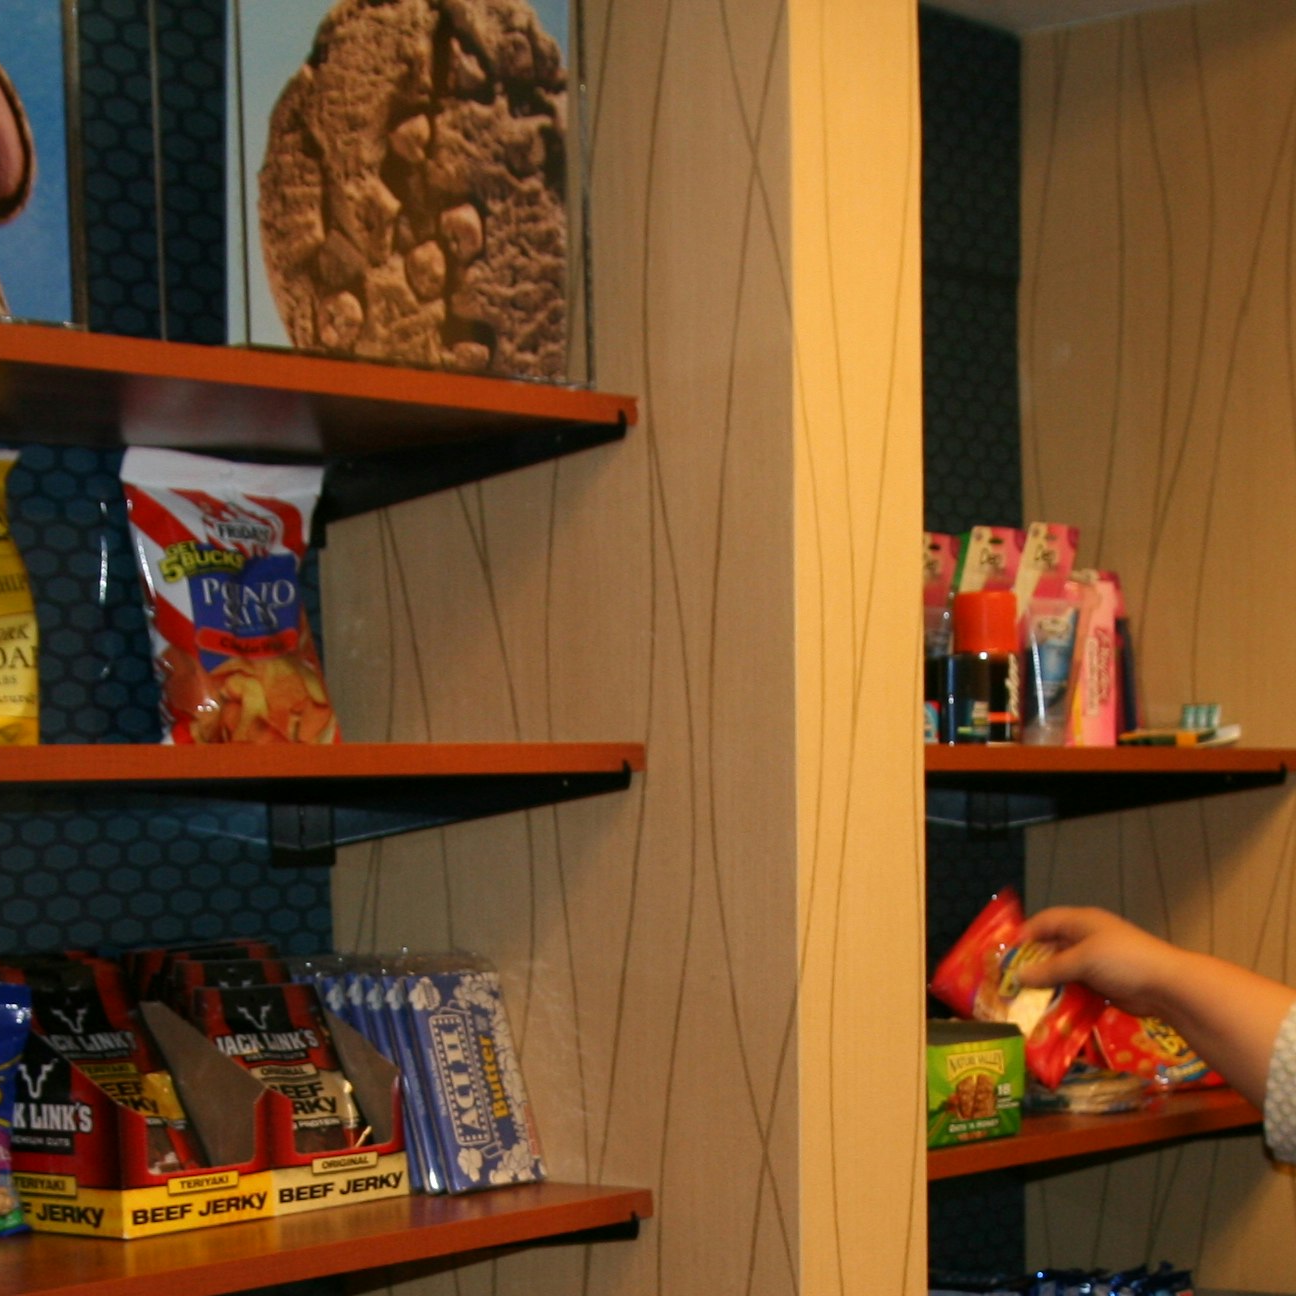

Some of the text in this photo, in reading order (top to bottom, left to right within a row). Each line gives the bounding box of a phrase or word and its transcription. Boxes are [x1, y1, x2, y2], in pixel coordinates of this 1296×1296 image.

[159, 558, 185, 583] 5
[215, 1027, 319, 1056] JACK LINK'S
[479, 1036, 510, 1118] Butter
[29, 1103, 93, 1133] LINK'S
[293, 1096, 337, 1114] RKY
[321, 1155, 379, 1171] ORIGINAL
[179, 1175, 231, 1190] TERIYAKI
[279, 1170, 404, 1204] BEEF JERKY
[36, 1203, 105, 1229] JERKY
[132, 1191, 268, 1225] BEEF JERKY
